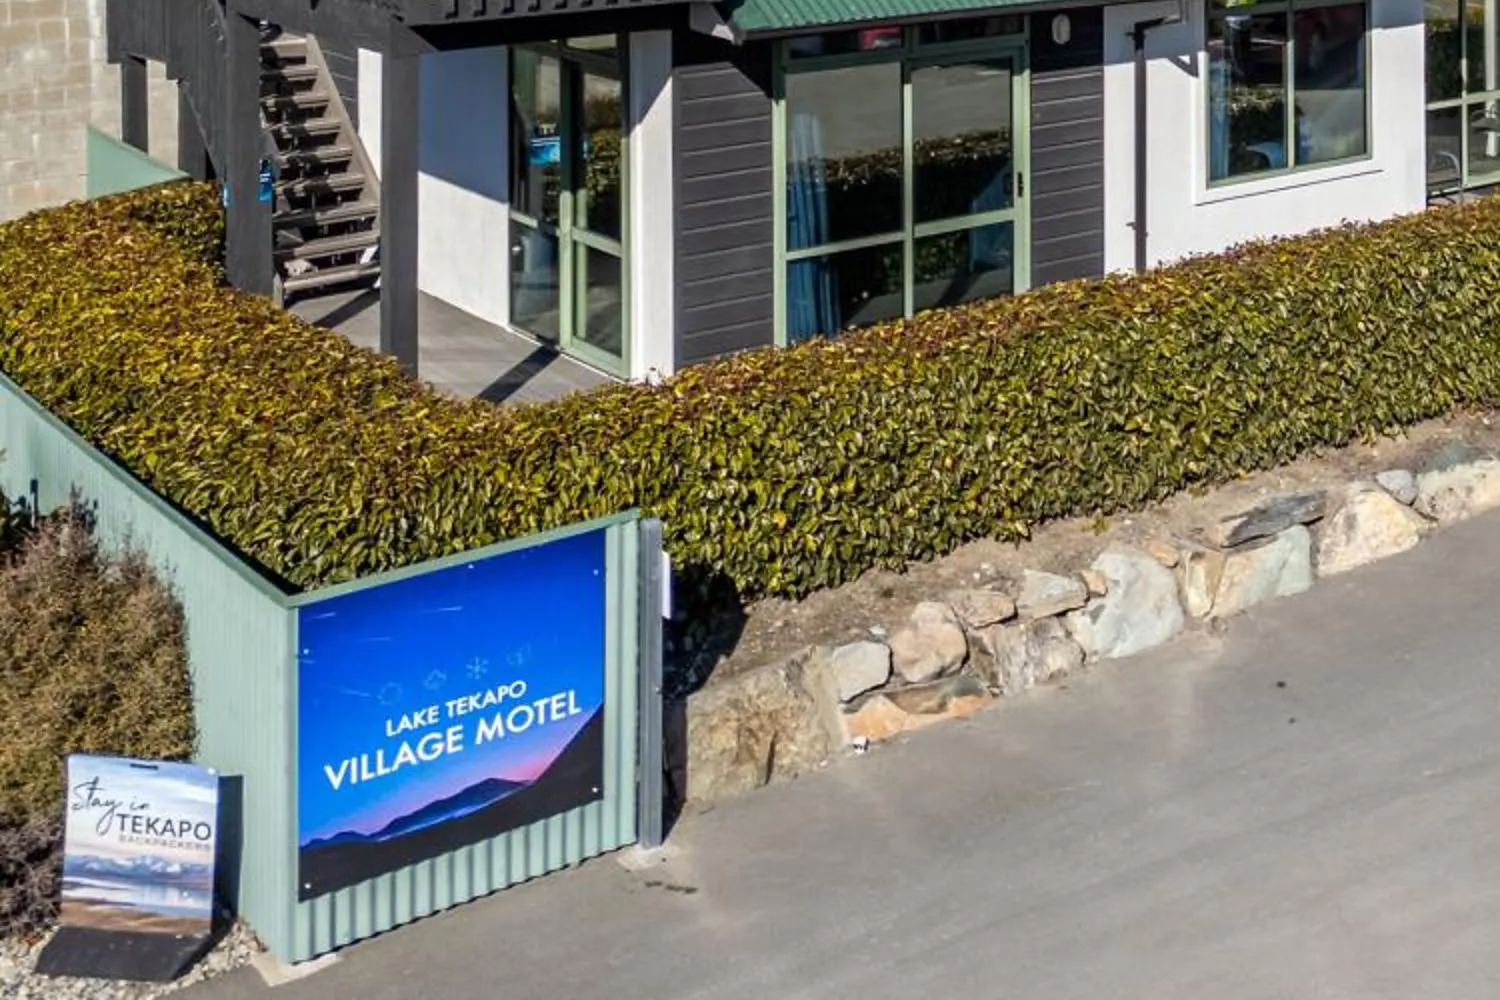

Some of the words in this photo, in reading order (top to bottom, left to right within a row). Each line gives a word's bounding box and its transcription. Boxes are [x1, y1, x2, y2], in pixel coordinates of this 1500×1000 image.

[385, 705, 440, 737] LAKE
[446, 680, 528, 718] TEKAPO
[324, 725, 464, 791] VILLAGE
[475, 690, 582, 745] MOTEL
[72, 776, 123, 836] Stay
[116, 813, 212, 841] TEKAPO
